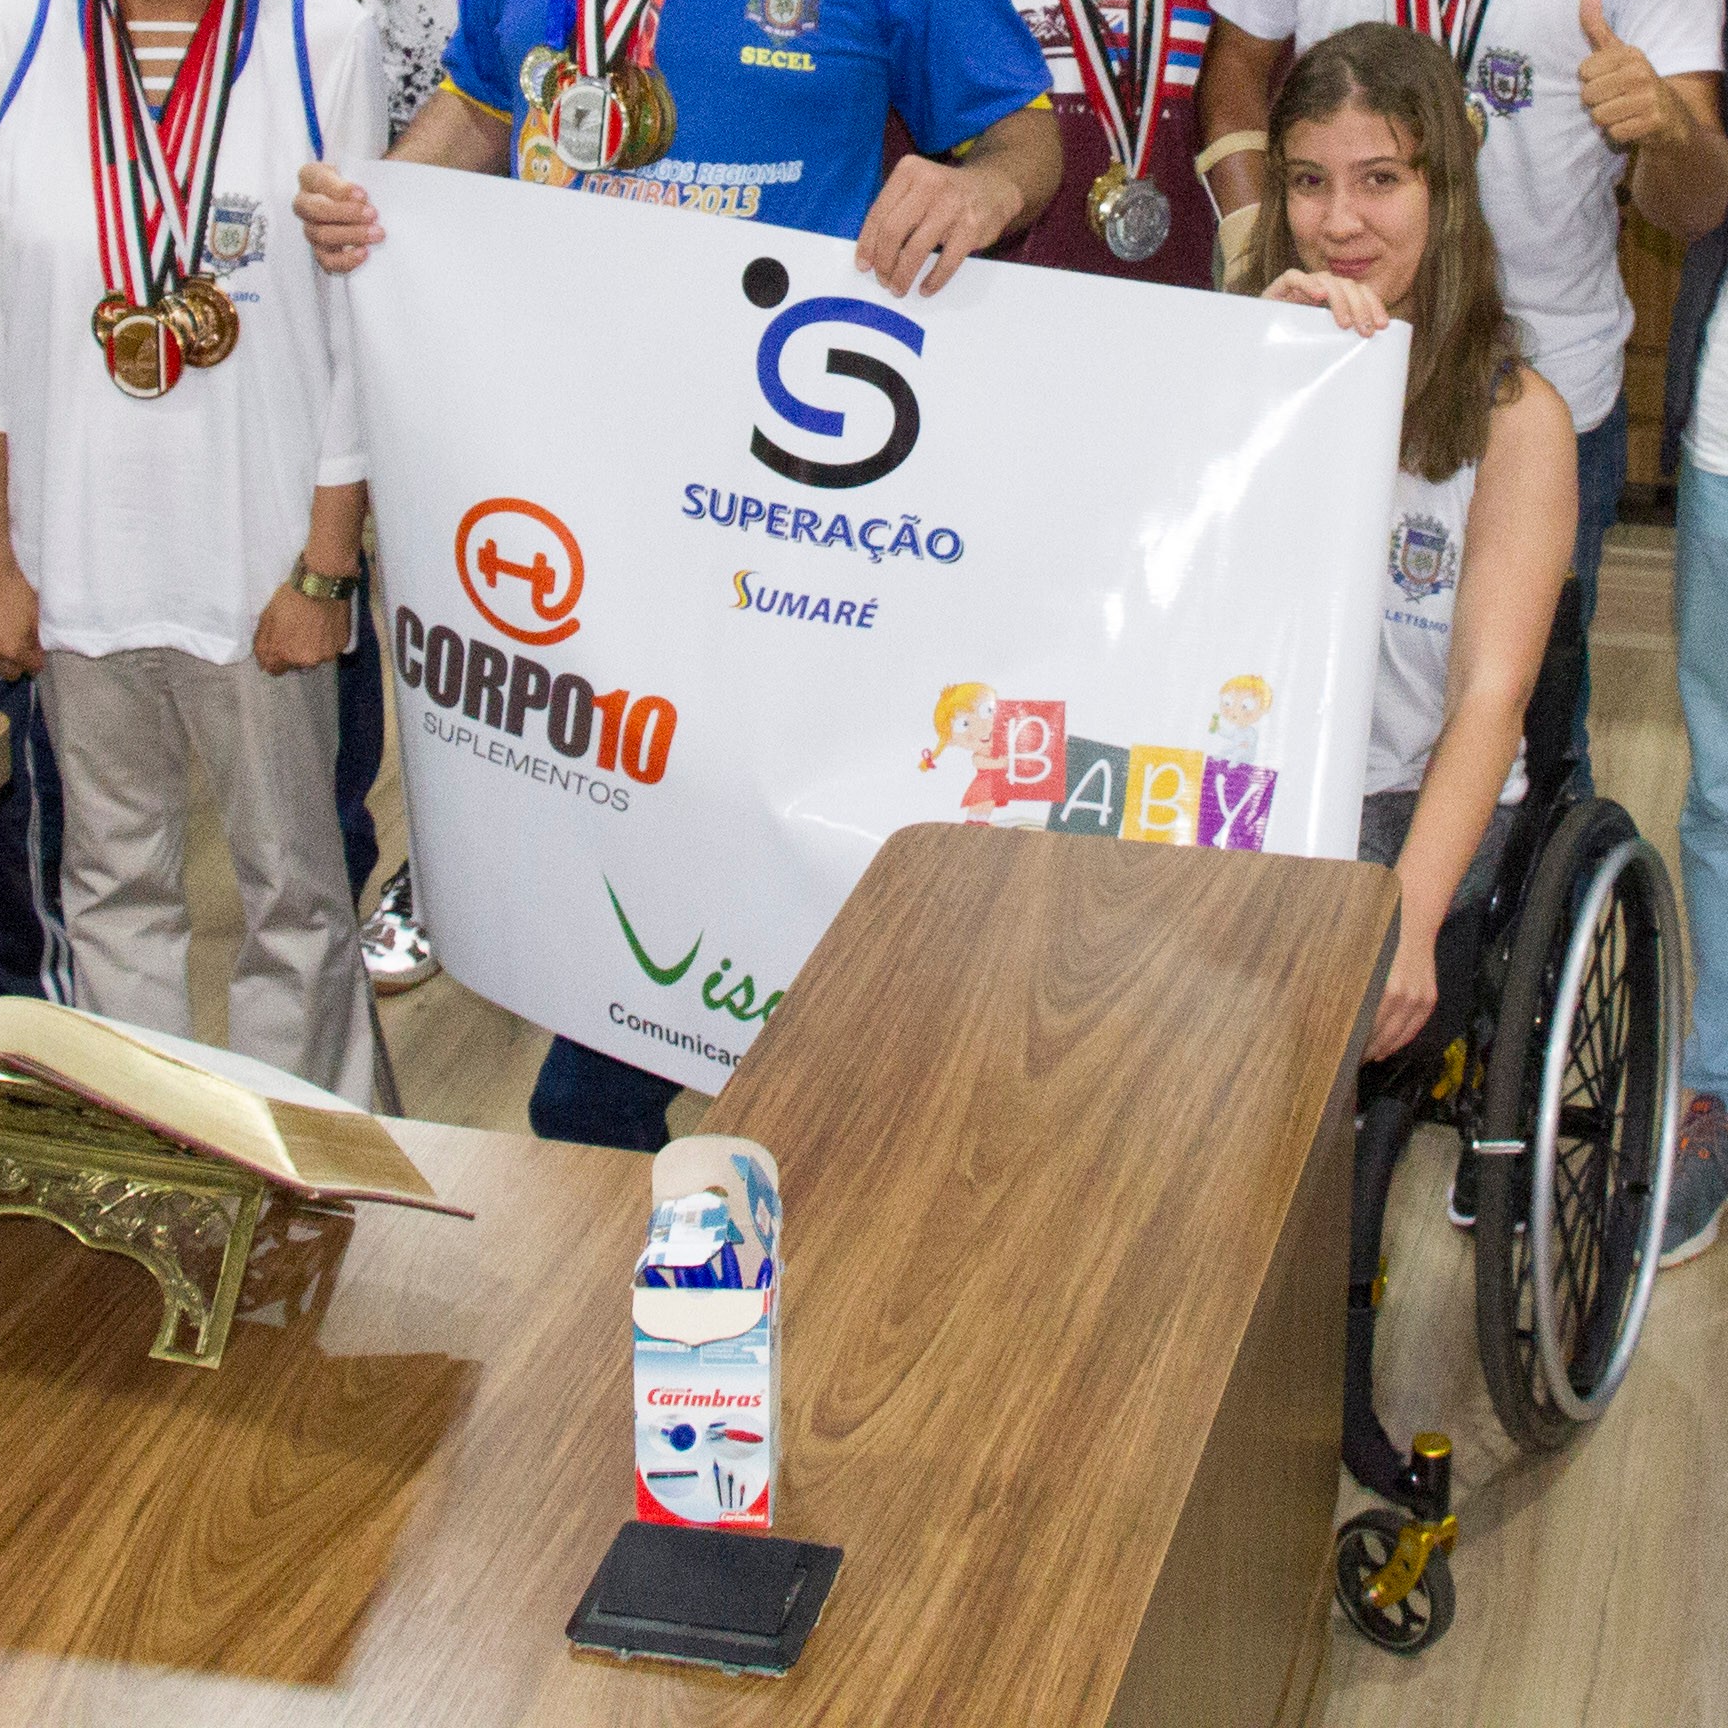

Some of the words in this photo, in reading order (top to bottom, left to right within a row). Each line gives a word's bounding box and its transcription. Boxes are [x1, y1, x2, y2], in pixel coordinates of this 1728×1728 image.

[739, 45, 817, 72] SECEL
[697, 160, 804, 185] REGIONAIS
[682, 483, 964, 564] SUPERAÇÃO
[395, 604, 677, 785] CORPO10
[423, 711, 630, 812] SUPLEMENTOS
[1007, 714, 1262, 849] BABY
[646, 1387, 763, 1409] Carimbras
